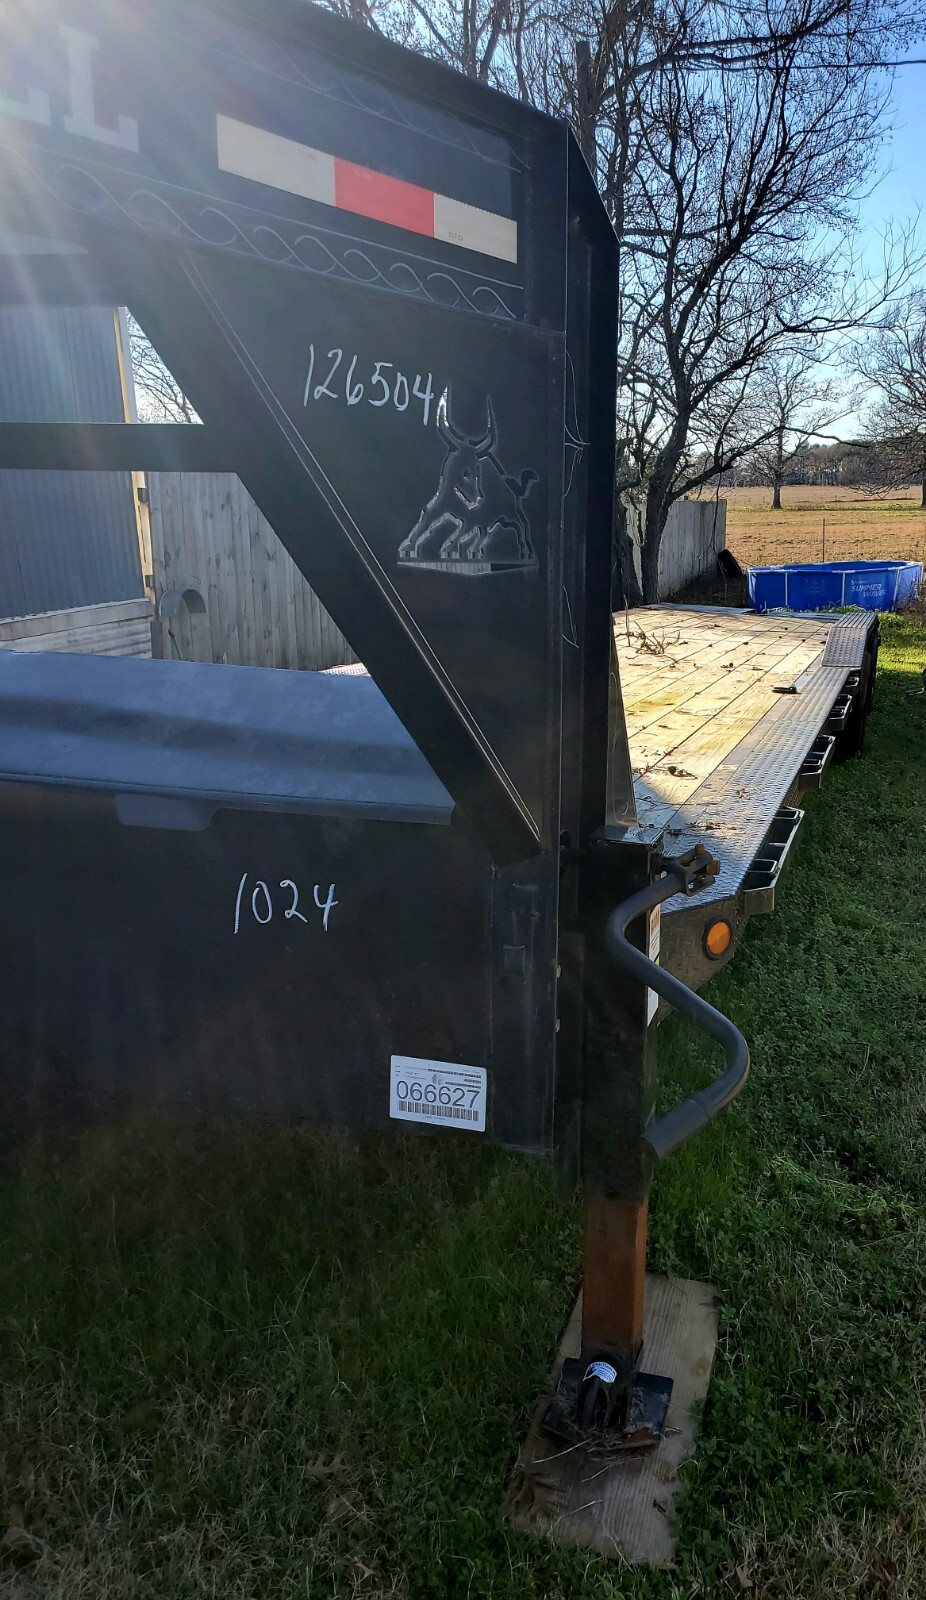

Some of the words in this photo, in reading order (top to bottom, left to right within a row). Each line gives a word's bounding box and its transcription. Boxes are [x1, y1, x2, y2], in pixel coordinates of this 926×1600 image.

[303, 344, 434, 426] 126504
[851, 583, 882, 592] SUMMER
[233, 872, 339, 935] 1024
[396, 1080, 480, 1109] 066627
